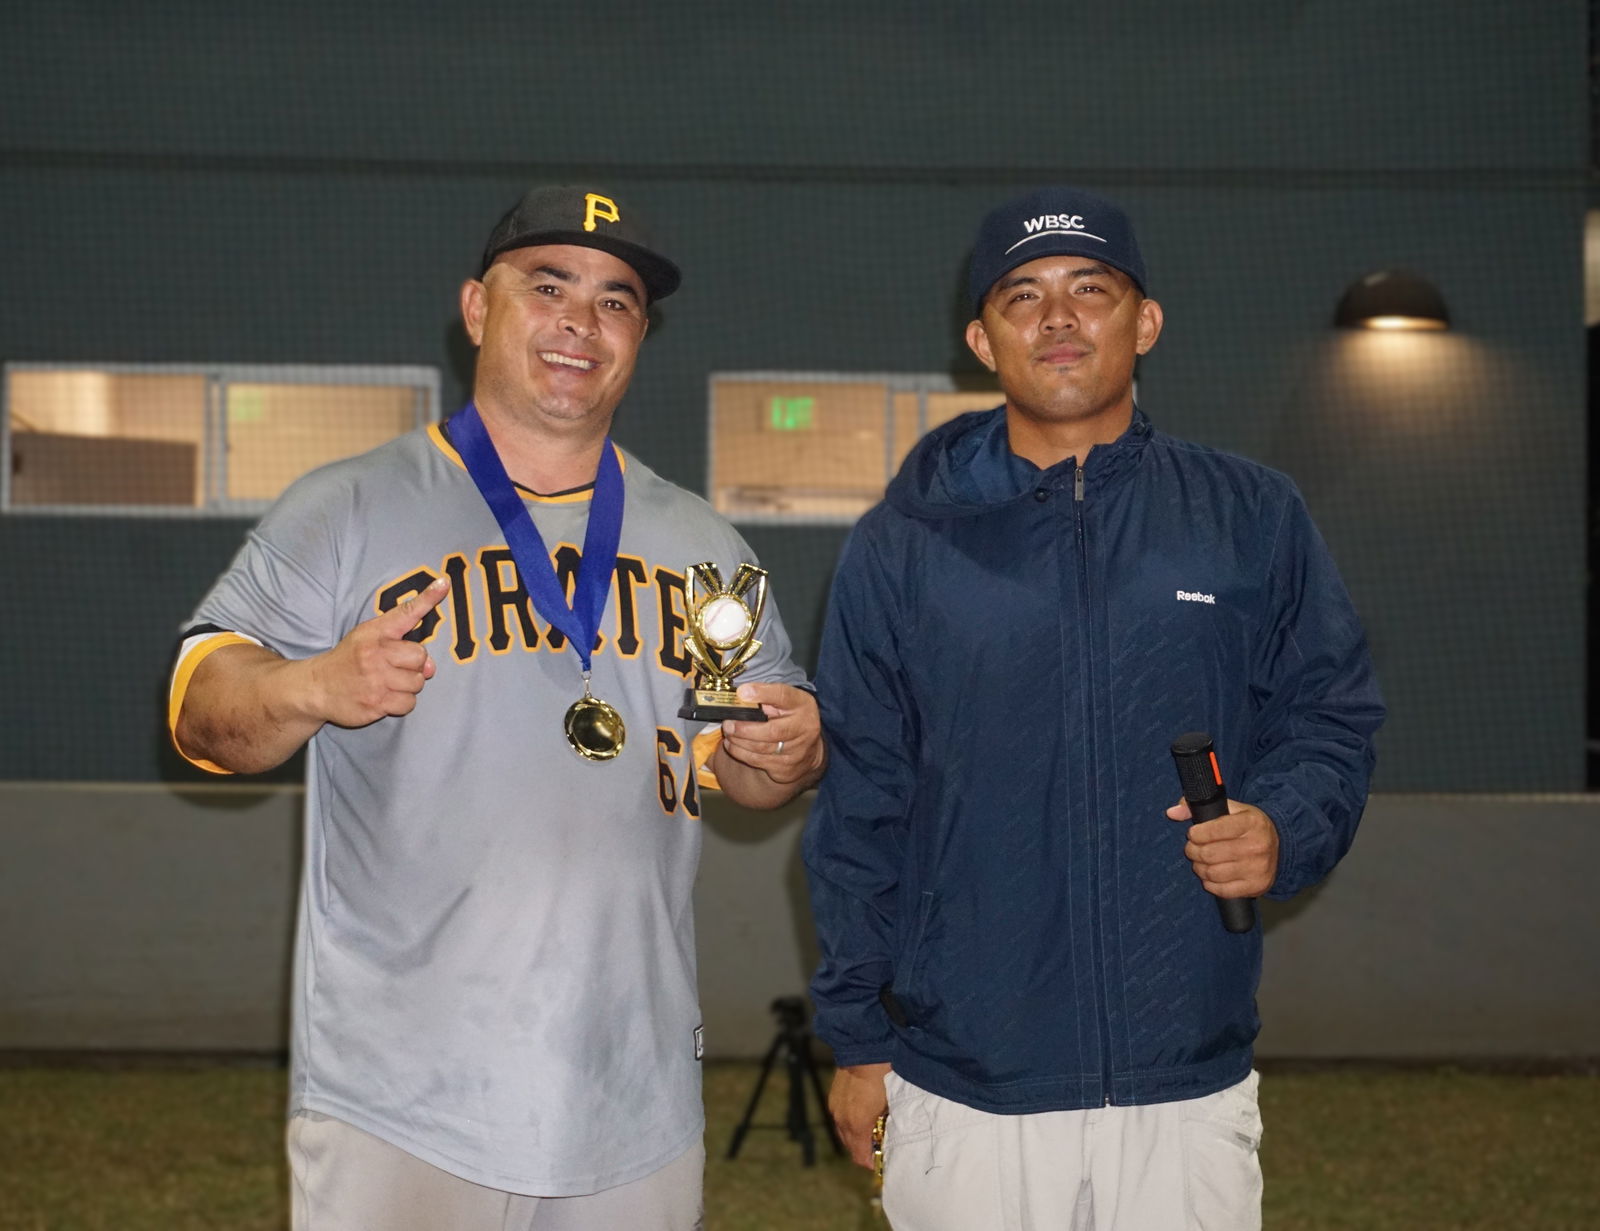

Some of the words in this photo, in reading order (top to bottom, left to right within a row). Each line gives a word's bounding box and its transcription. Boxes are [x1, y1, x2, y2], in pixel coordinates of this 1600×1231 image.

[583, 193, 621, 232] P
[1023, 213, 1085, 233] WBSC
[1176, 590, 1216, 605] Reebok
